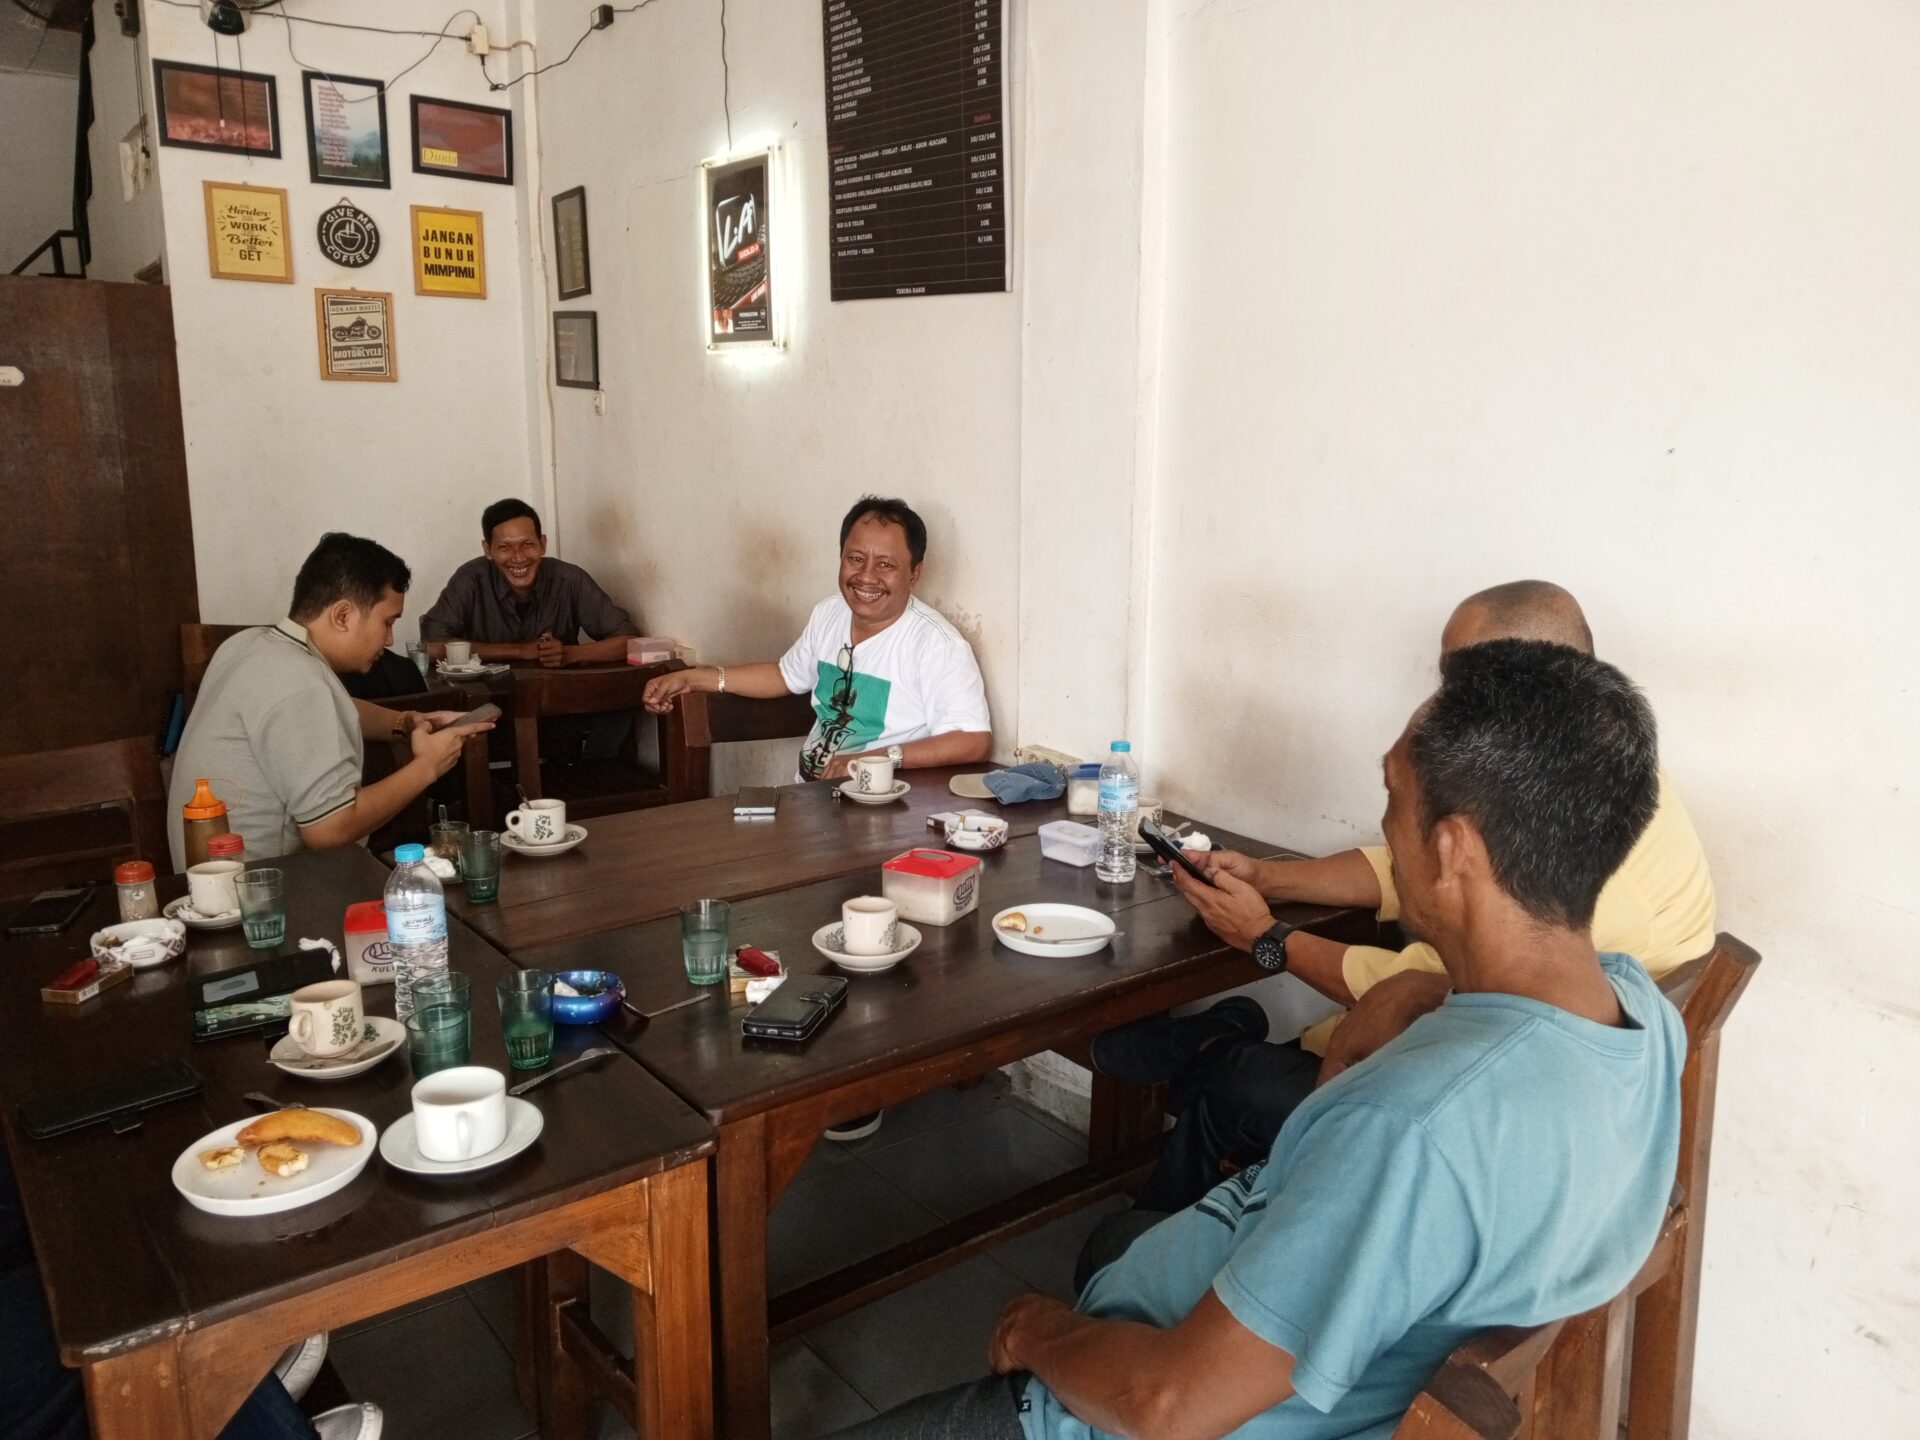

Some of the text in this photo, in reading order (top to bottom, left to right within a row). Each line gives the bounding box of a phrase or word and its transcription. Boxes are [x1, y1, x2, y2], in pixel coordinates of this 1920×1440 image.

[230, 221, 267, 232] WORK
[326, 208, 375, 231] GIVE ME
[980, 219, 990, 227] 10K
[226, 233, 273, 247] Better
[423, 229, 473, 245] JANGAN
[239, 249, 262, 261] GET
[326, 245, 370, 265] COFFEE
[423, 246, 474, 262] BUNUH
[424, 263, 475, 279] MIMPIMU
[330, 304, 344, 313] IRON
[346, 304, 358, 312] AND
[334, 347, 382, 360] MOTORCYCLE
